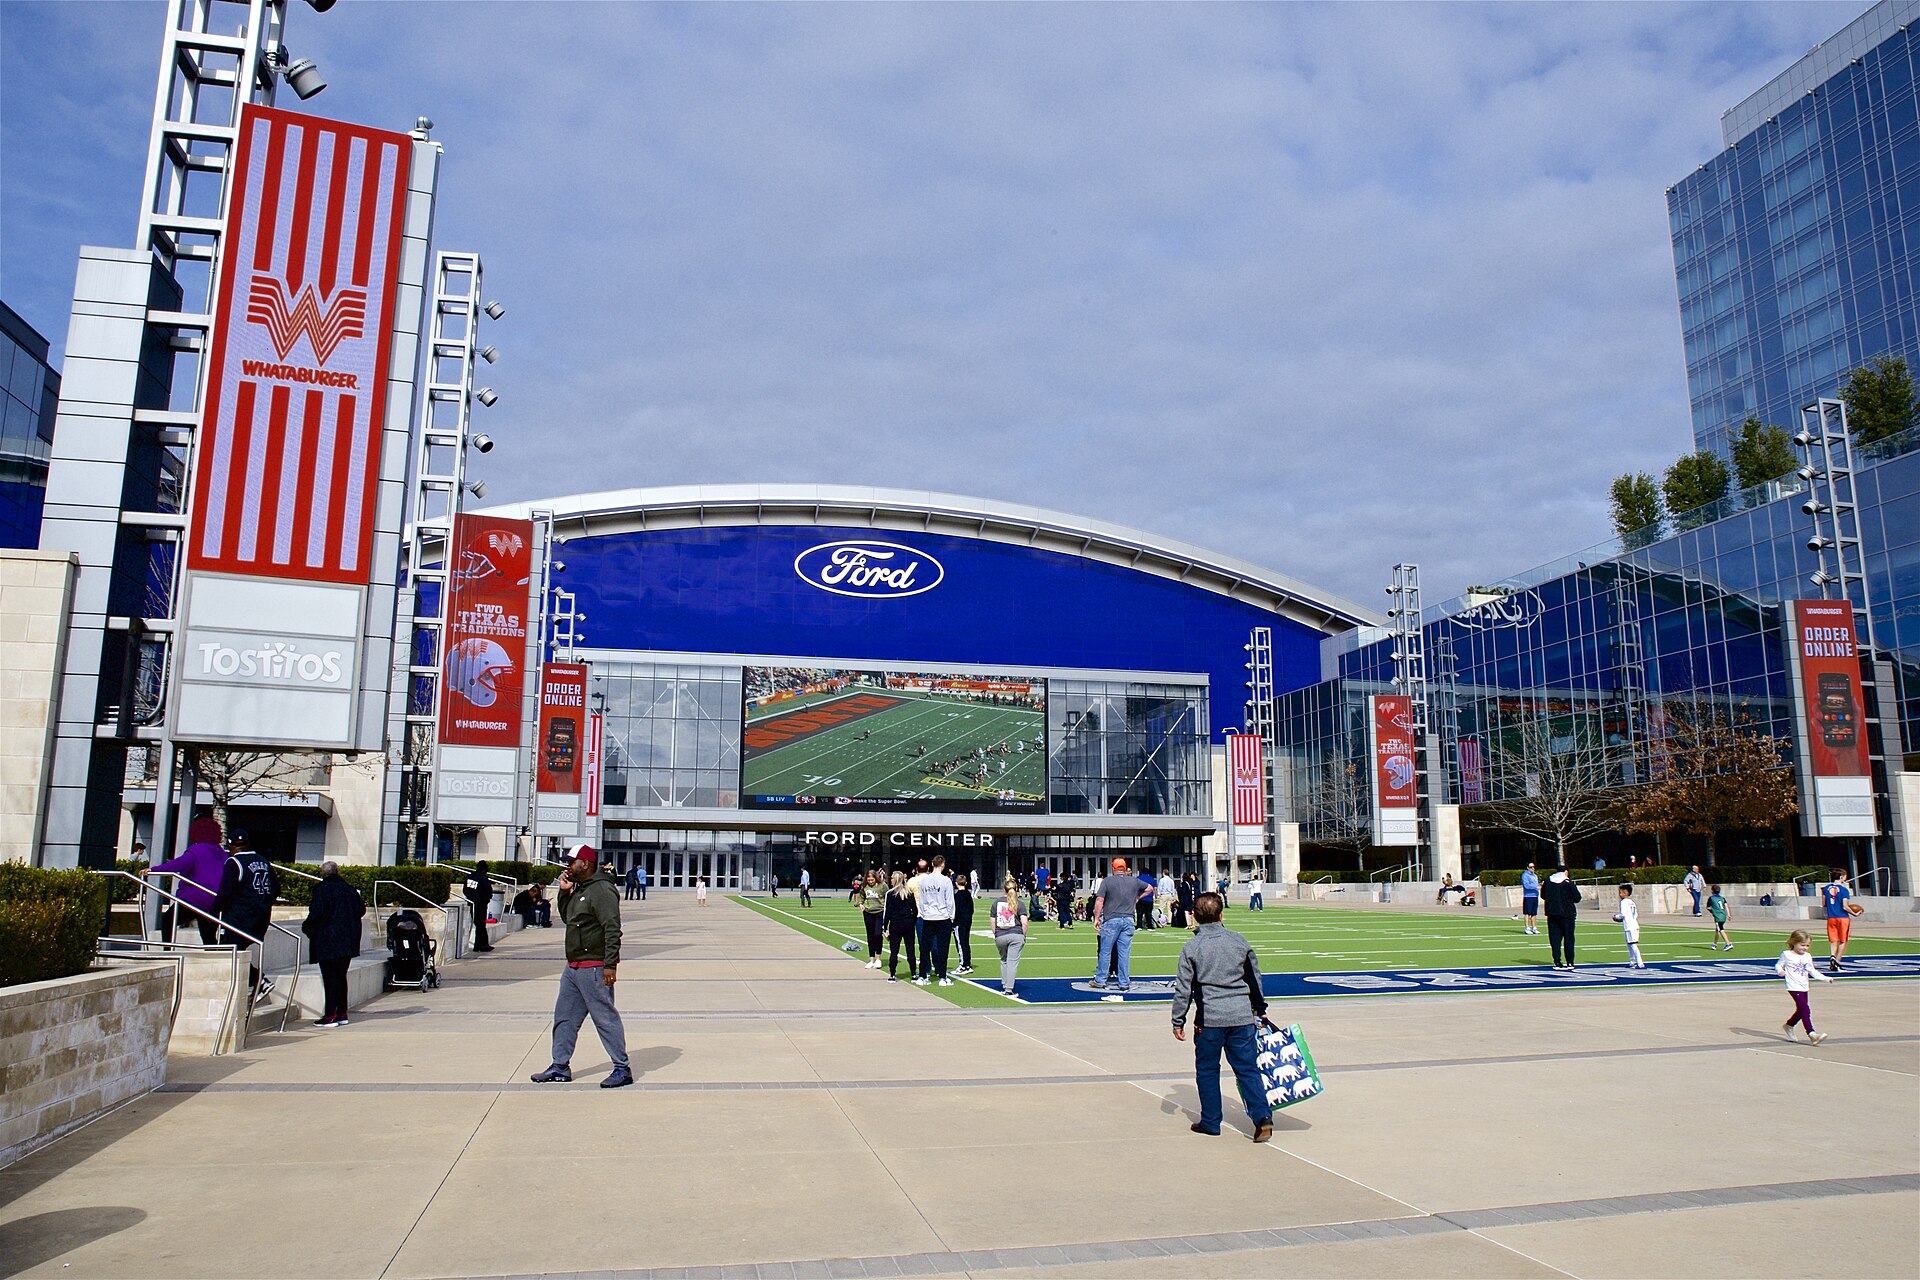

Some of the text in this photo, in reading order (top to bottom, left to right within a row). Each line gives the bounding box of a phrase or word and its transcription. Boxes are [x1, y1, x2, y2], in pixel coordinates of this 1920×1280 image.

[242, 359, 360, 390] WHATABURGER
[821, 547, 919, 589] Ford
[475, 604, 503, 614] TWO
[458, 611, 519, 628] TEXAS
[451, 624, 525, 637] TRADITIONS
[1804, 627, 1849, 641] ORDER
[1804, 643, 1853, 657] ONLINE
[546, 683, 582, 695] ORDER
[544, 694, 583, 707] ONLINE
[456, 720, 508, 731] WHATABURGER
[805, 831, 993, 847] FORD CENTER
